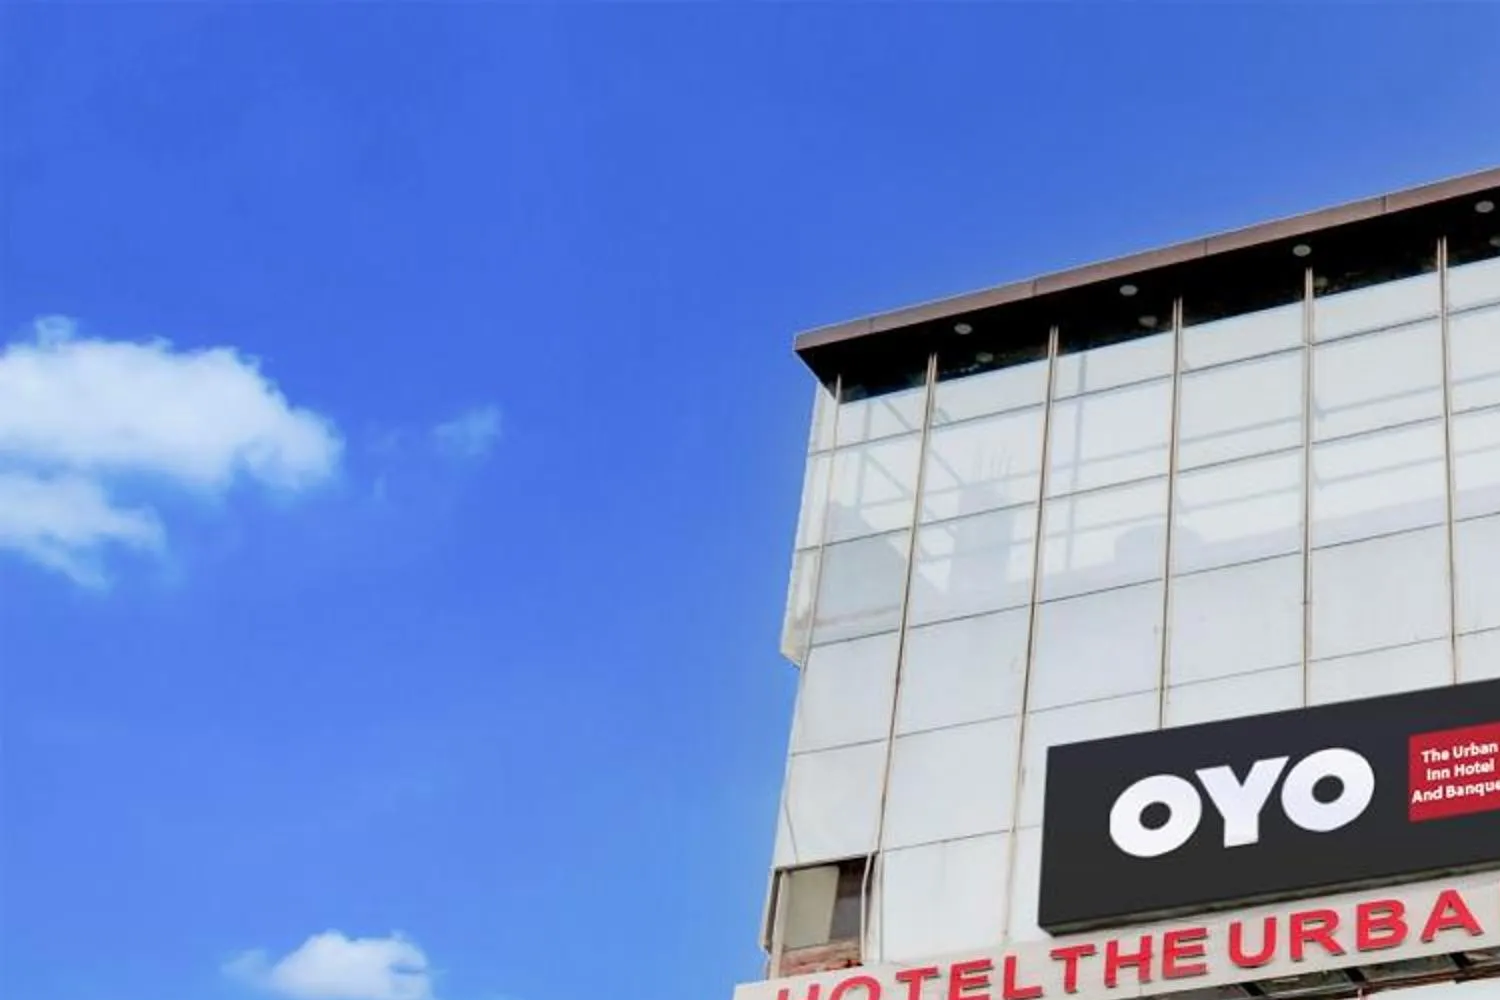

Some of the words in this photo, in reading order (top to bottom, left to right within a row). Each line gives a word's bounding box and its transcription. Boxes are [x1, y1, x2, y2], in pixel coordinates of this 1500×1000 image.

[1421, 748, 1450, 763] The
[1452, 742, 1499, 759] Urban
[1426, 767, 1451, 781] Inn
[1454, 758, 1495, 777] Hotel
[1109, 747, 1375, 858] OYO
[1412, 785, 1443, 803] And
[1050, 927, 1209, 994] THE
